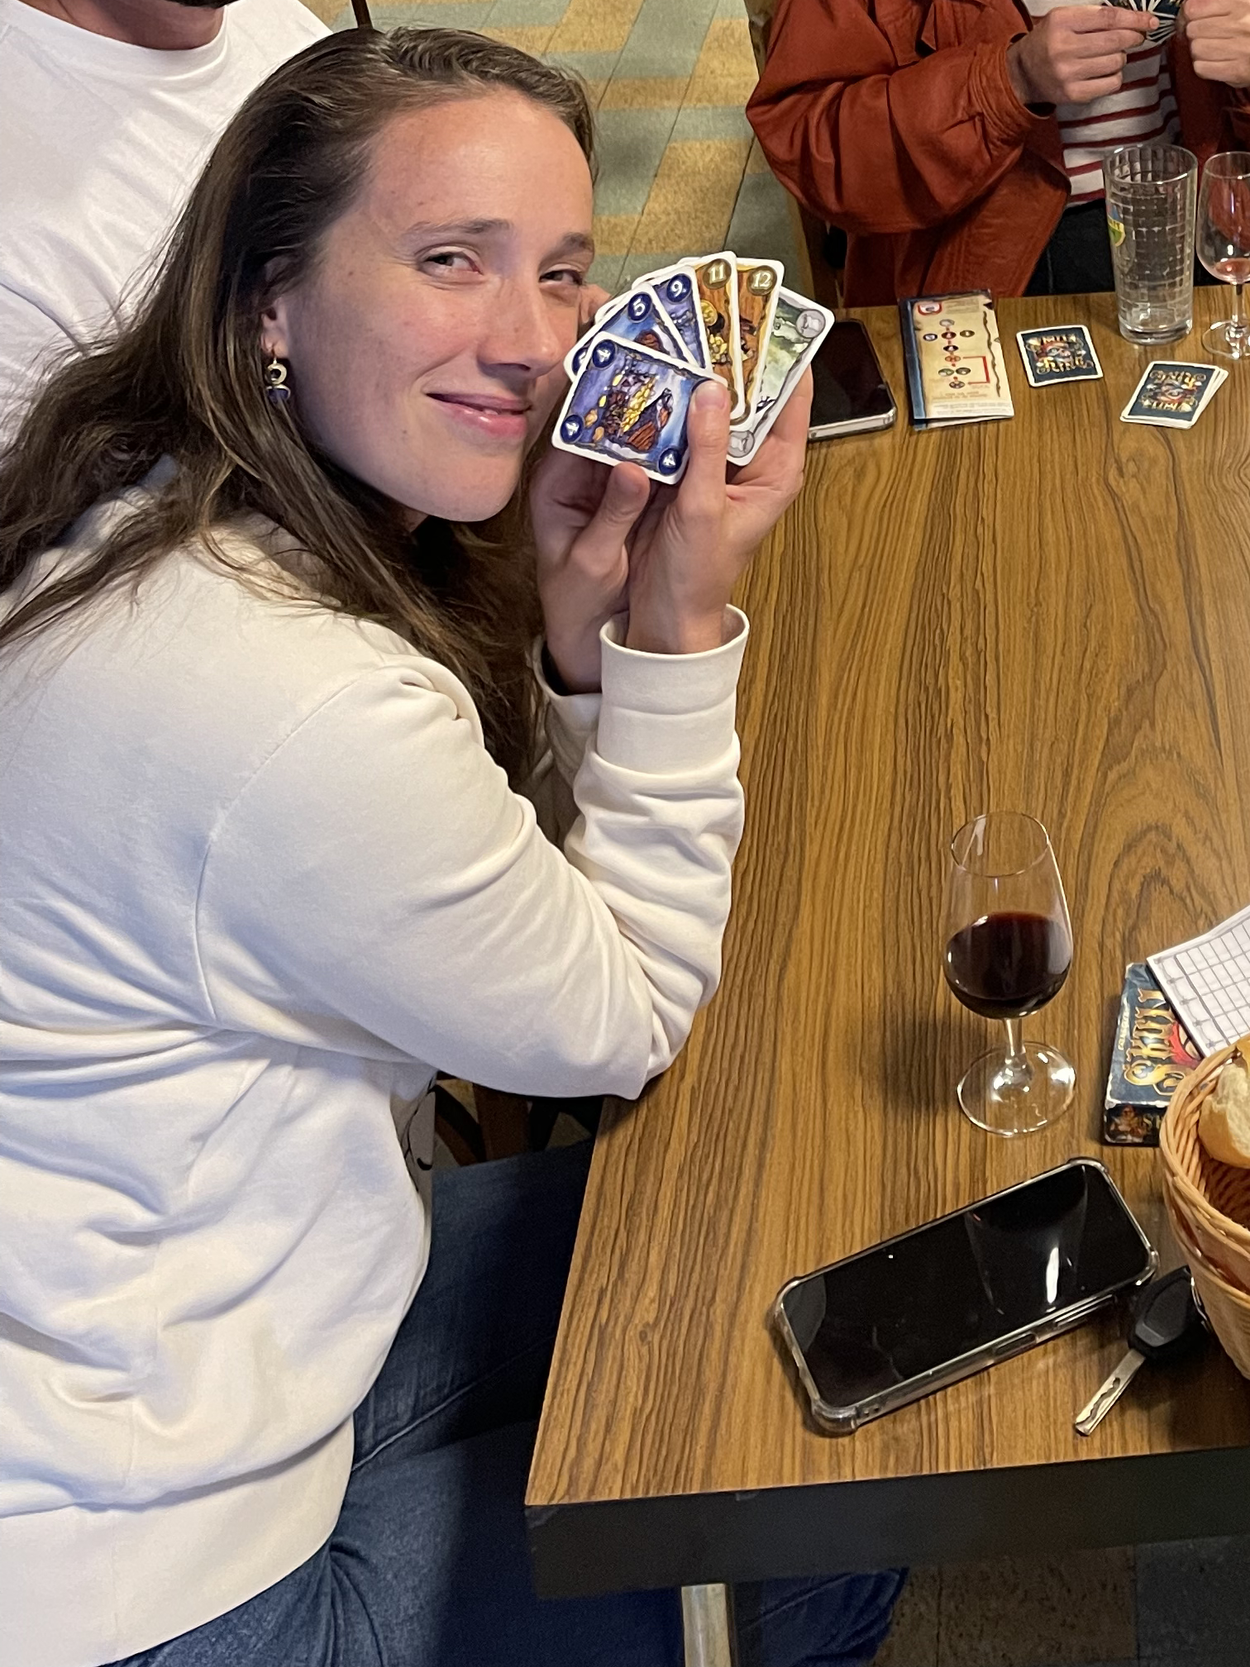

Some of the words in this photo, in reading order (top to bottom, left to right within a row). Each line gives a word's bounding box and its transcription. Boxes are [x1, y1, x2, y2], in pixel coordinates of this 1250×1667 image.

[709, 266, 726, 283] 11
[753, 272, 772, 288] 12
[632, 300, 646, 317] 5
